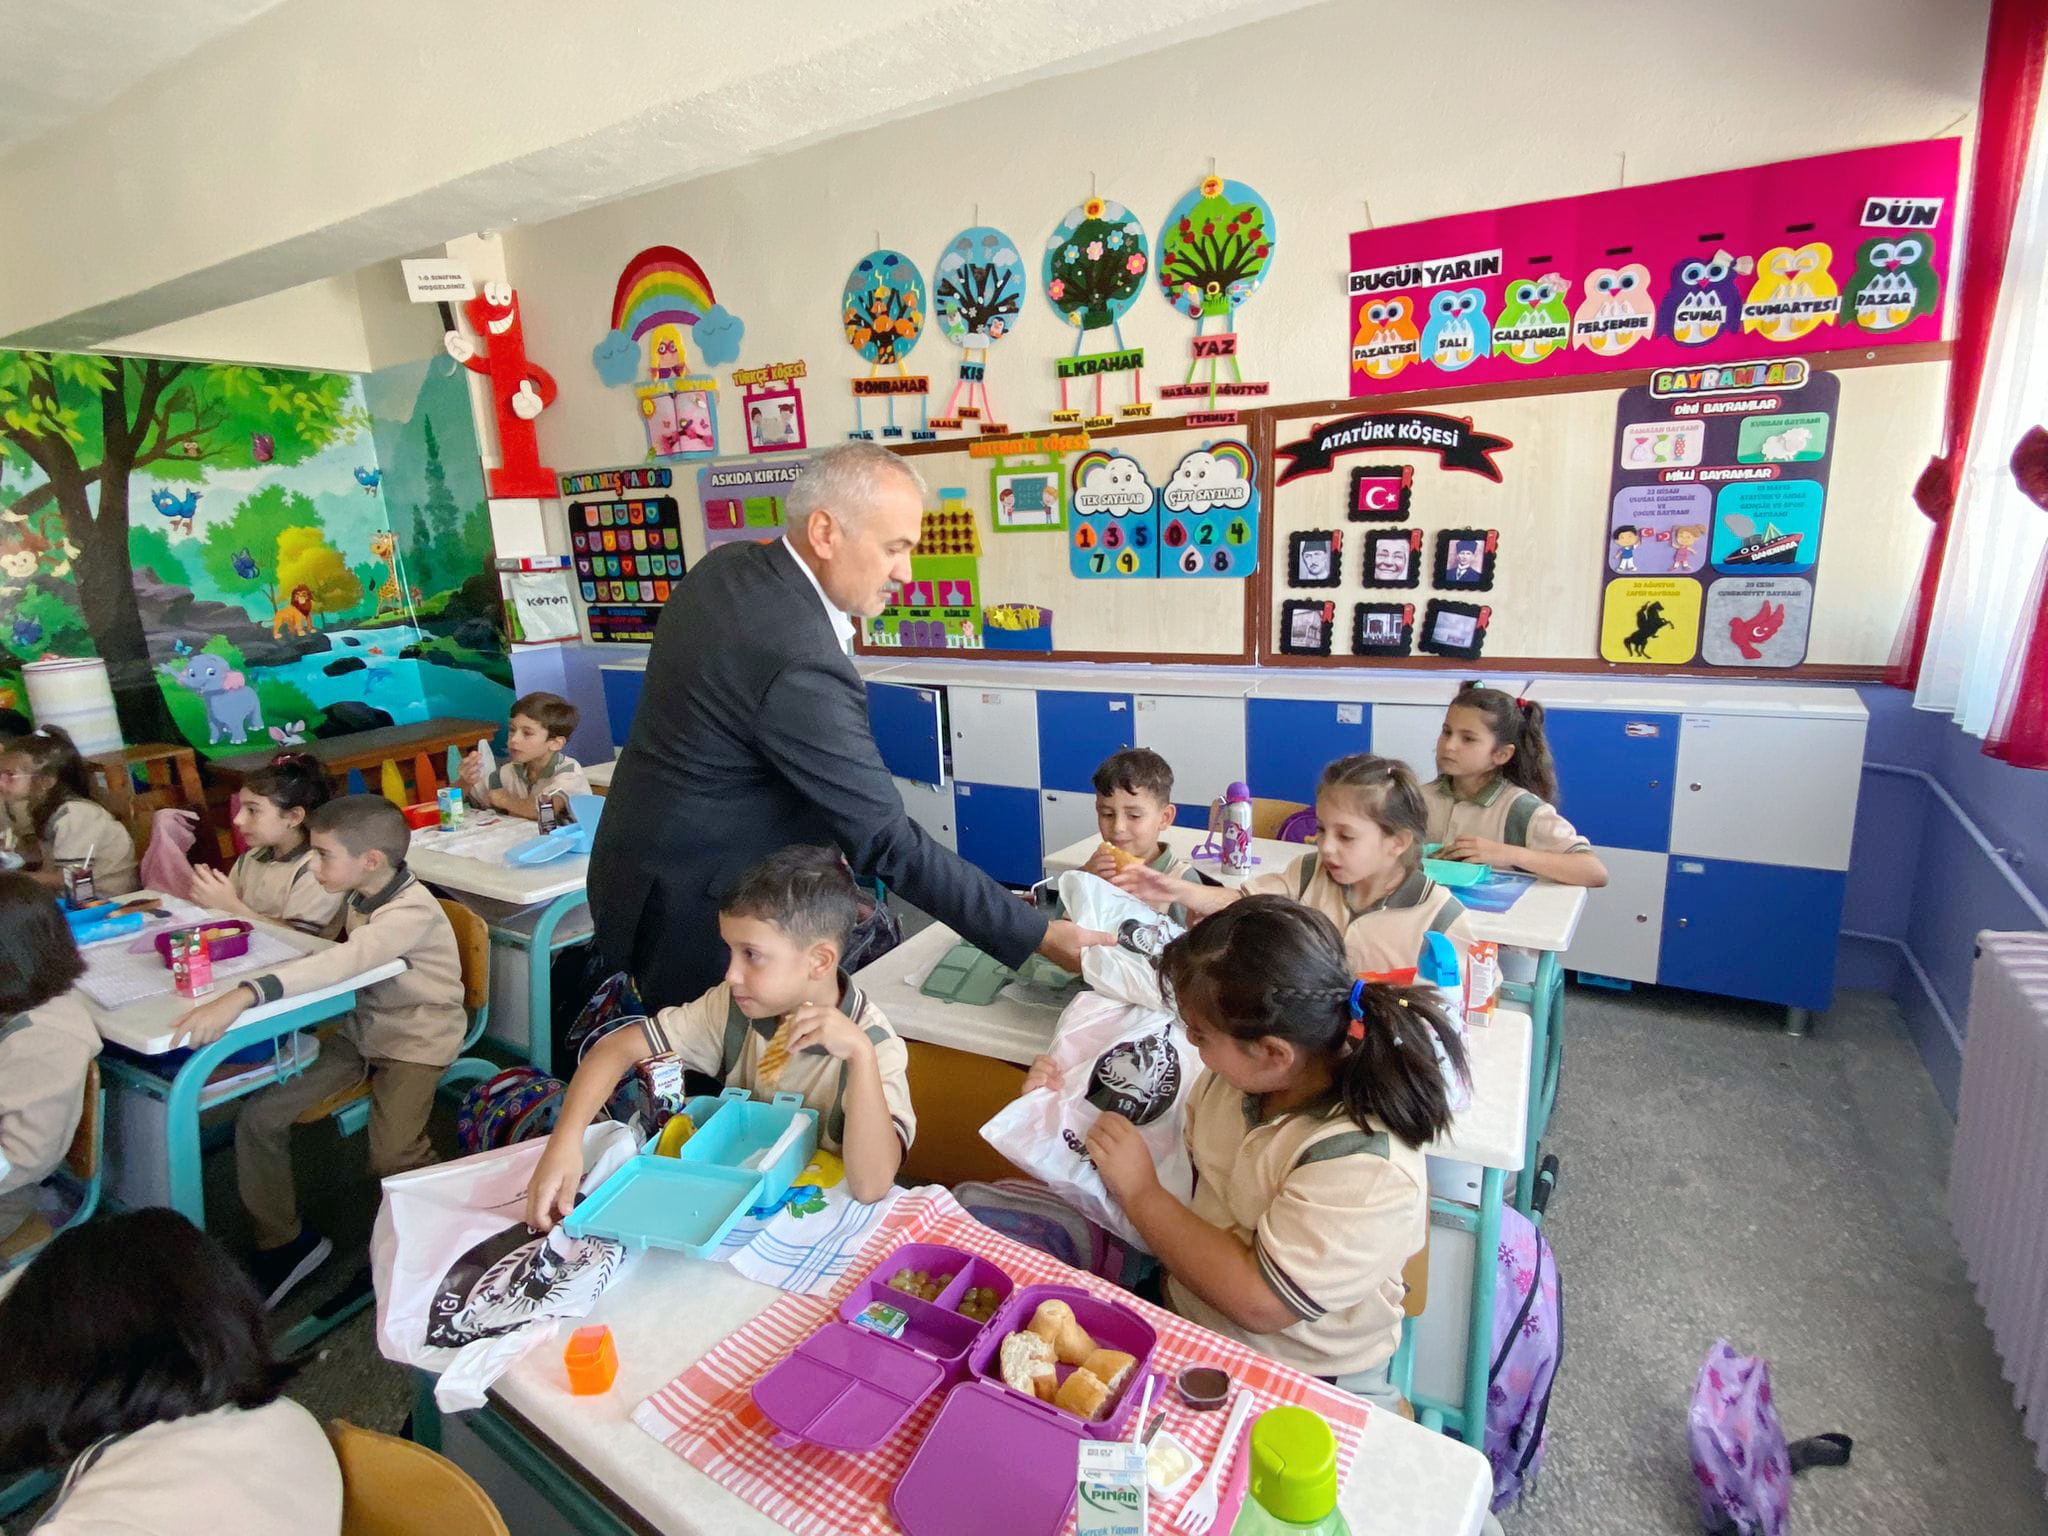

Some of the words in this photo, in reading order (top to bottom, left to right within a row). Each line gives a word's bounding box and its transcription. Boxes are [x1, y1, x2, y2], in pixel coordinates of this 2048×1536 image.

[1865, 200, 1938, 225] DÜN
[1424, 256, 1499, 283] YARIN
[1745, 296, 1838, 316] CUMARTESİ
[1857, 291, 1910, 305] PAZAR
[1677, 310, 1722, 322] CUMA
[1577, 317, 1648, 334] PERŞEMBE
[1193, 340, 1235, 356] YAZ
[1355, 340, 1416, 359] PAZARTESİ
[1439, 338, 1467, 348] SALI
[1058, 353, 1144, 378] İLKBAHAR
[732, 369, 769, 388] TÜRKÇE
[1656, 362, 1804, 393] BAYRAMLAR
[854, 379, 928, 395] SONBAHAR
[1674, 402, 1699, 415] DİNİ
[1703, 399, 1777, 414] BAYRAMLAR
[1053, 413, 1079, 423] MART
[1085, 417, 1113, 429] NİSAN
[1188, 413, 1236, 424] TEMMUZ
[1321, 422, 1395, 451] ATATÜRK
[1399, 420, 1459, 447] KÖŞESİ
[711, 471, 753, 487] ASKIDA
[1665, 468, 1695, 481] MİLLİ
[1699, 468, 1772, 480] BAYRAMLAR
[1081, 494, 1099, 506] TEK
[1101, 493, 1144, 505] SAYILAR
[1169, 488, 1196, 507] ÇİFT
[1197, 487, 1243, 501] SAYILAR
[1080, 528, 1091, 548] 1
[1107, 527, 1119, 546] 3
[1135, 526, 1147, 544] 5
[1170, 527, 1182, 545] 0
[1201, 524, 1212, 545] 2
[1231, 523, 1244, 544] 4
[1093, 553, 1105, 573] 7
[1122, 553, 1132, 572] 9
[1184, 552, 1197, 571] 6
[1214, 551, 1229, 571] 8
[1091, 1488, 1139, 1504] PINAR
